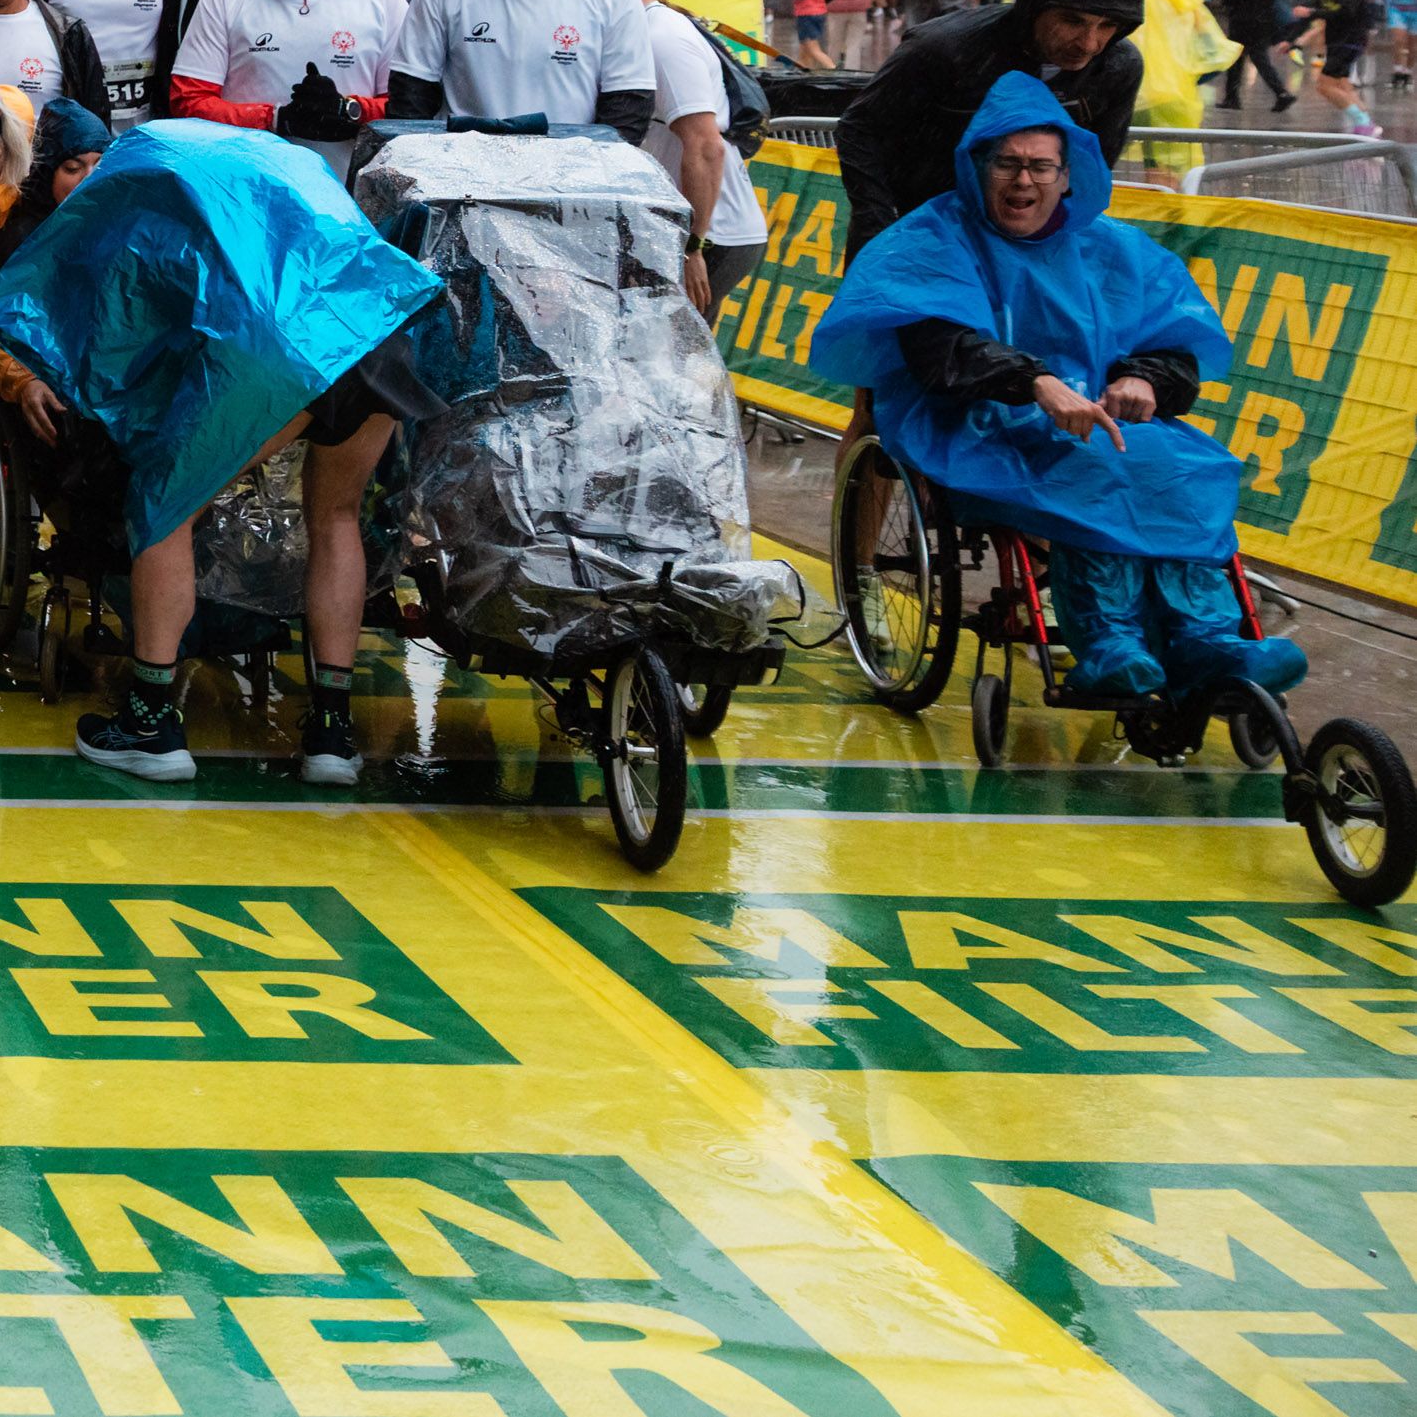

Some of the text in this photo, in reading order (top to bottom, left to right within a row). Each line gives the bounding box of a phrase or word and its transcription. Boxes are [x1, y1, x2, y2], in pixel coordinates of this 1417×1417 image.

[757, 190, 847, 279] MA
[714, 278, 835, 367] FILT
[1185, 257, 1352, 383] NN
[695, 977, 1417, 1056] FILTE
